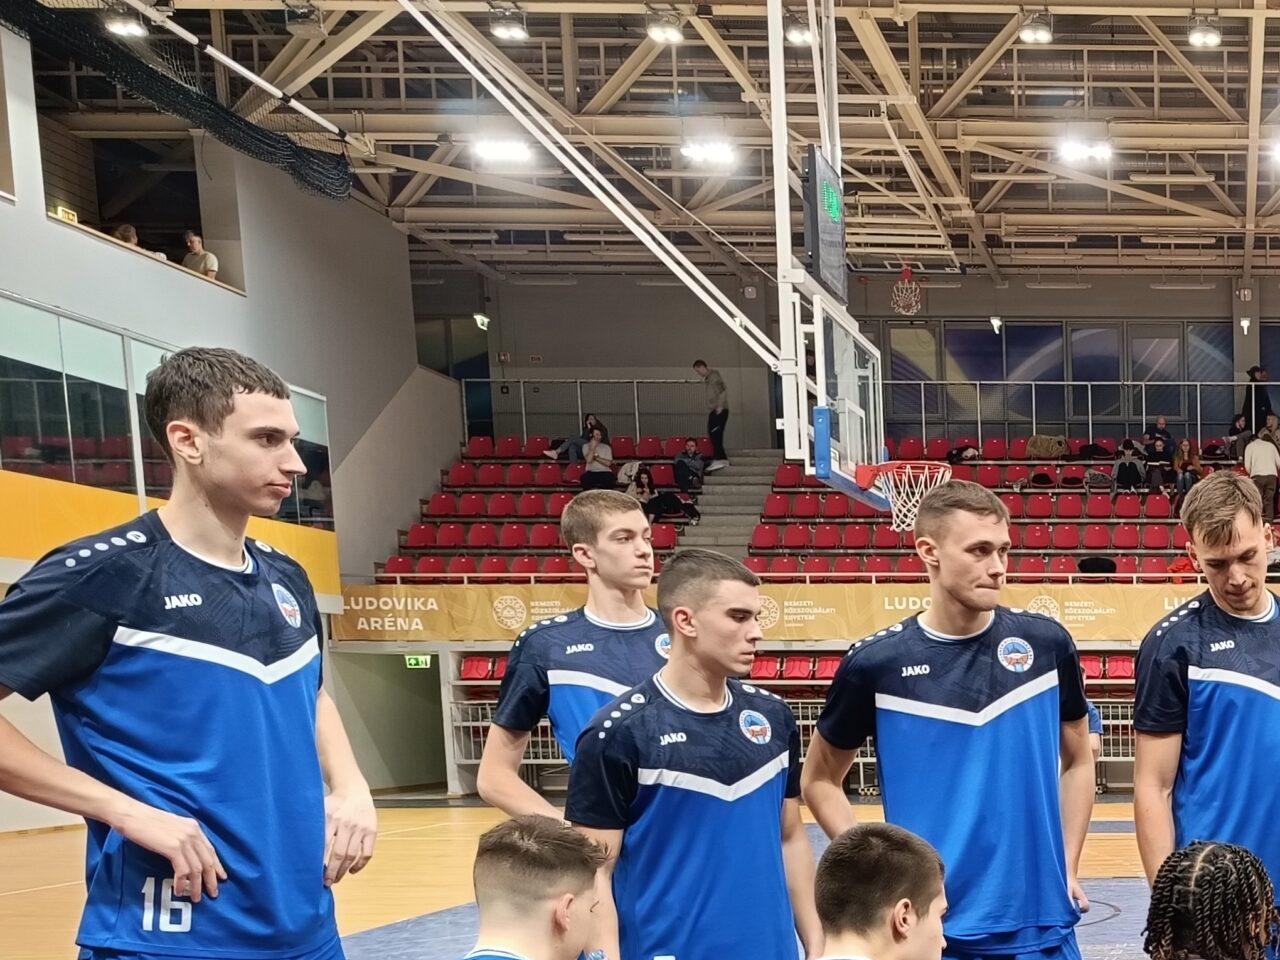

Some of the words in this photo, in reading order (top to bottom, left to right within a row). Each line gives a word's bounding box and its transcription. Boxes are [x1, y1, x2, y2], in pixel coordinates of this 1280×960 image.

[164, 594, 203, 610] JAKO
[884, 597, 933, 610] LUDO
[357, 613, 424, 631] ARÉNA
[565, 644, 594, 654] JAKO
[1210, 640, 1235, 652] JAKO
[901, 665, 930, 677] JAKO
[660, 732, 687, 745] JAKO
[141, 877, 193, 933] 16
